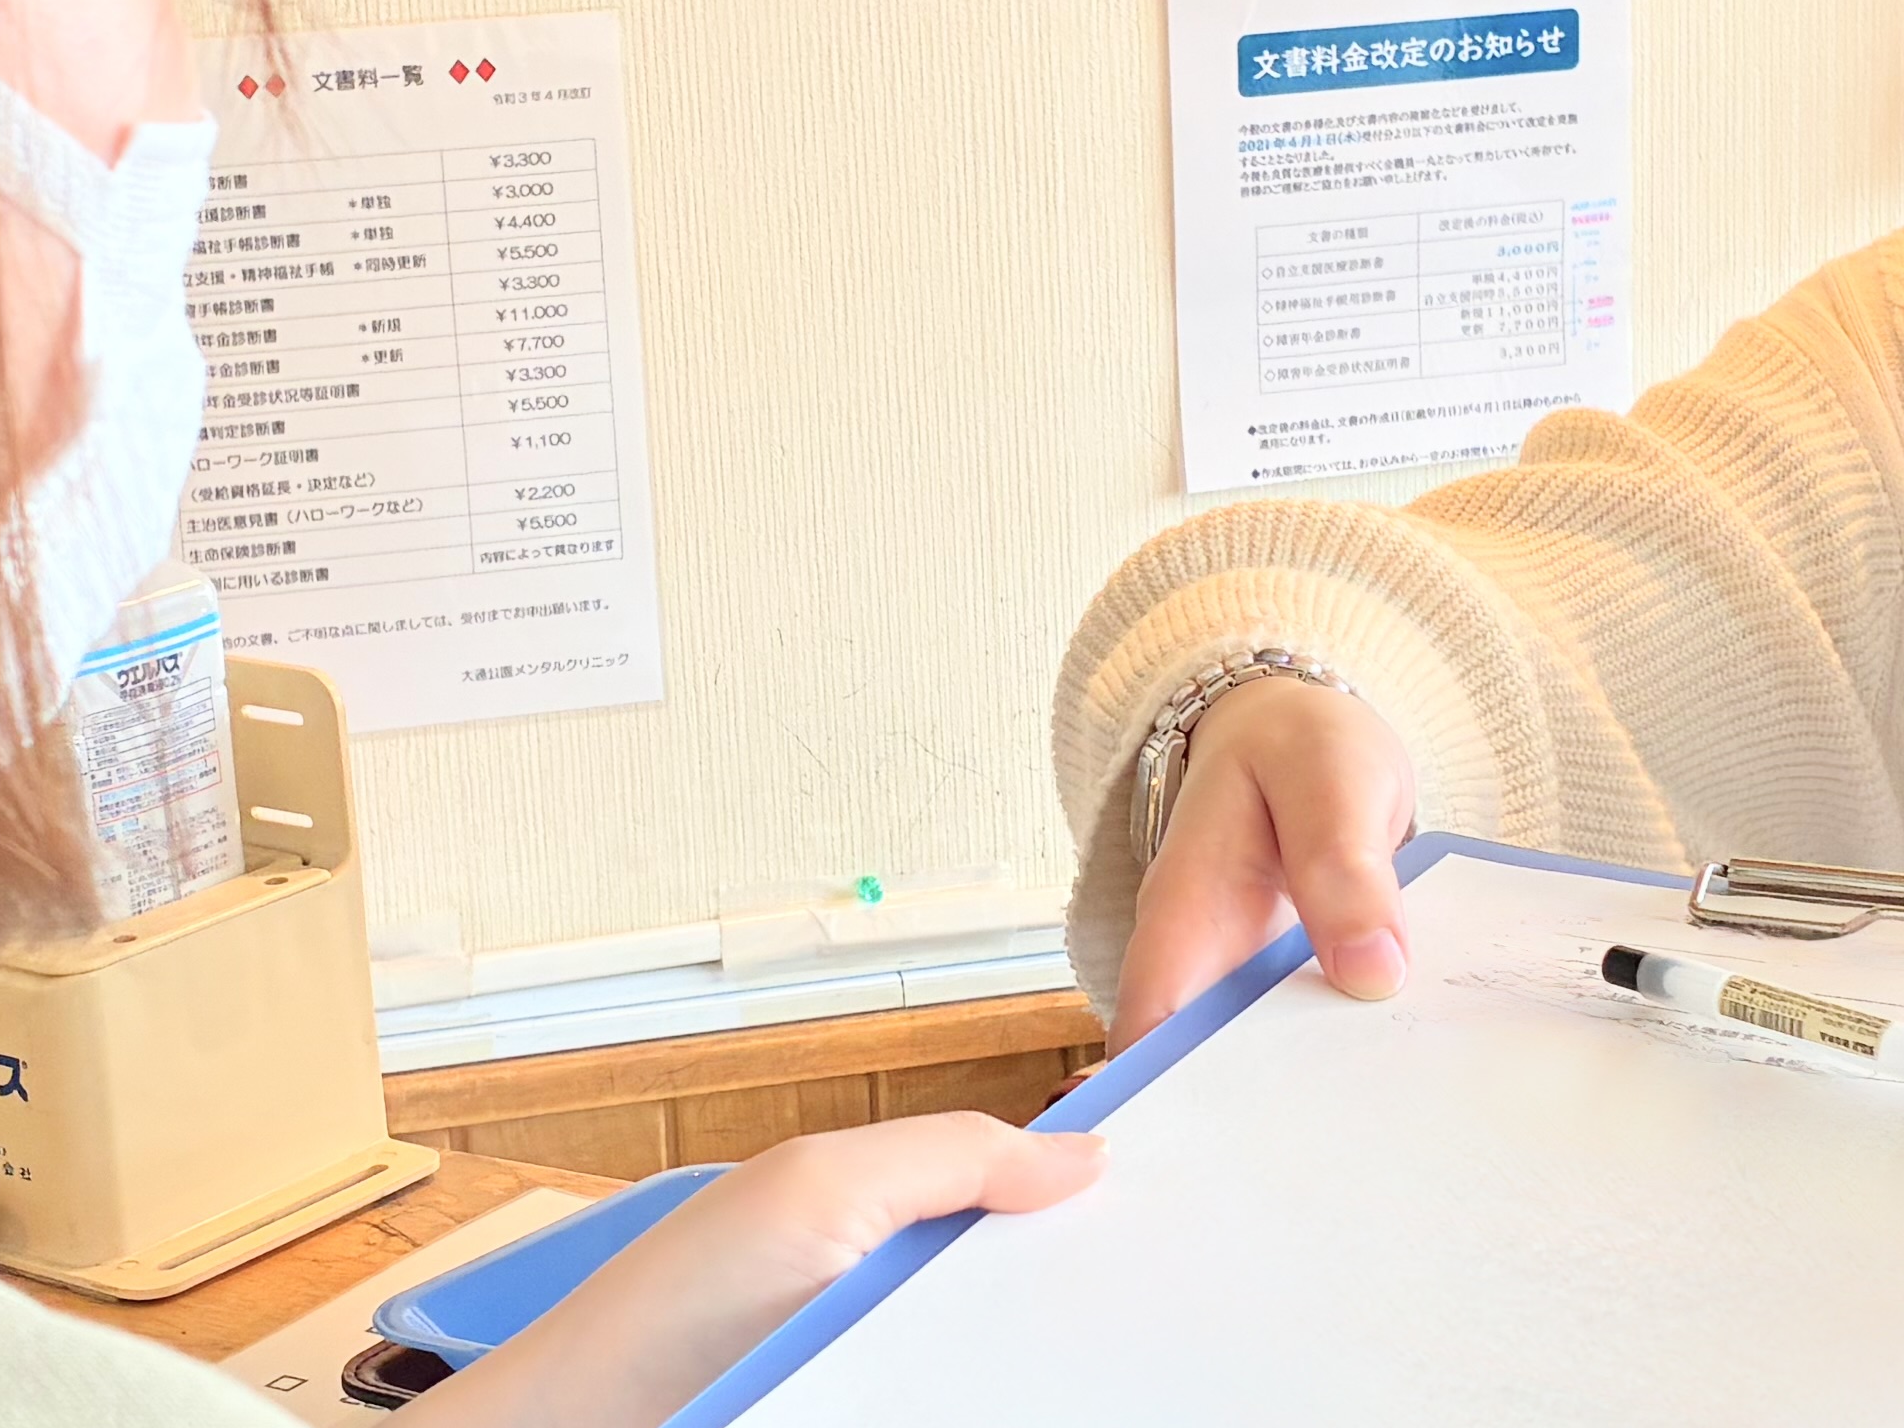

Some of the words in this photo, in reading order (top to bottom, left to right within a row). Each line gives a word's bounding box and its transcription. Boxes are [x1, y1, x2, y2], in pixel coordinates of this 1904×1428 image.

[1252, 25, 1566, 81] 文書料金改定のお知らせ
[312, 65, 424, 92] 文書料一覧
[489, 151, 552, 169] ¥3,300
[197, 204, 267, 224] 援診断書
[492, 182, 554, 200] ¥3,000
[494, 213, 556, 231] ¥4,400
[497, 243, 559, 262] ¥5,500
[499, 274, 560, 292] ¥3,300
[195, 329, 278, 348] 年金診断書
[496, 304, 568, 323] ¥11,000
[504, 335, 565, 352] ¥7,700
[203, 383, 361, 410] 年金受診状況等証明書
[506, 365, 567, 383] ¥3,300
[508, 395, 569, 413] ¥5,500
[511, 432, 572, 450] ¥1,100
[514, 483, 576, 501] ¥2,200
[516, 513, 577, 531] ¥5,500
